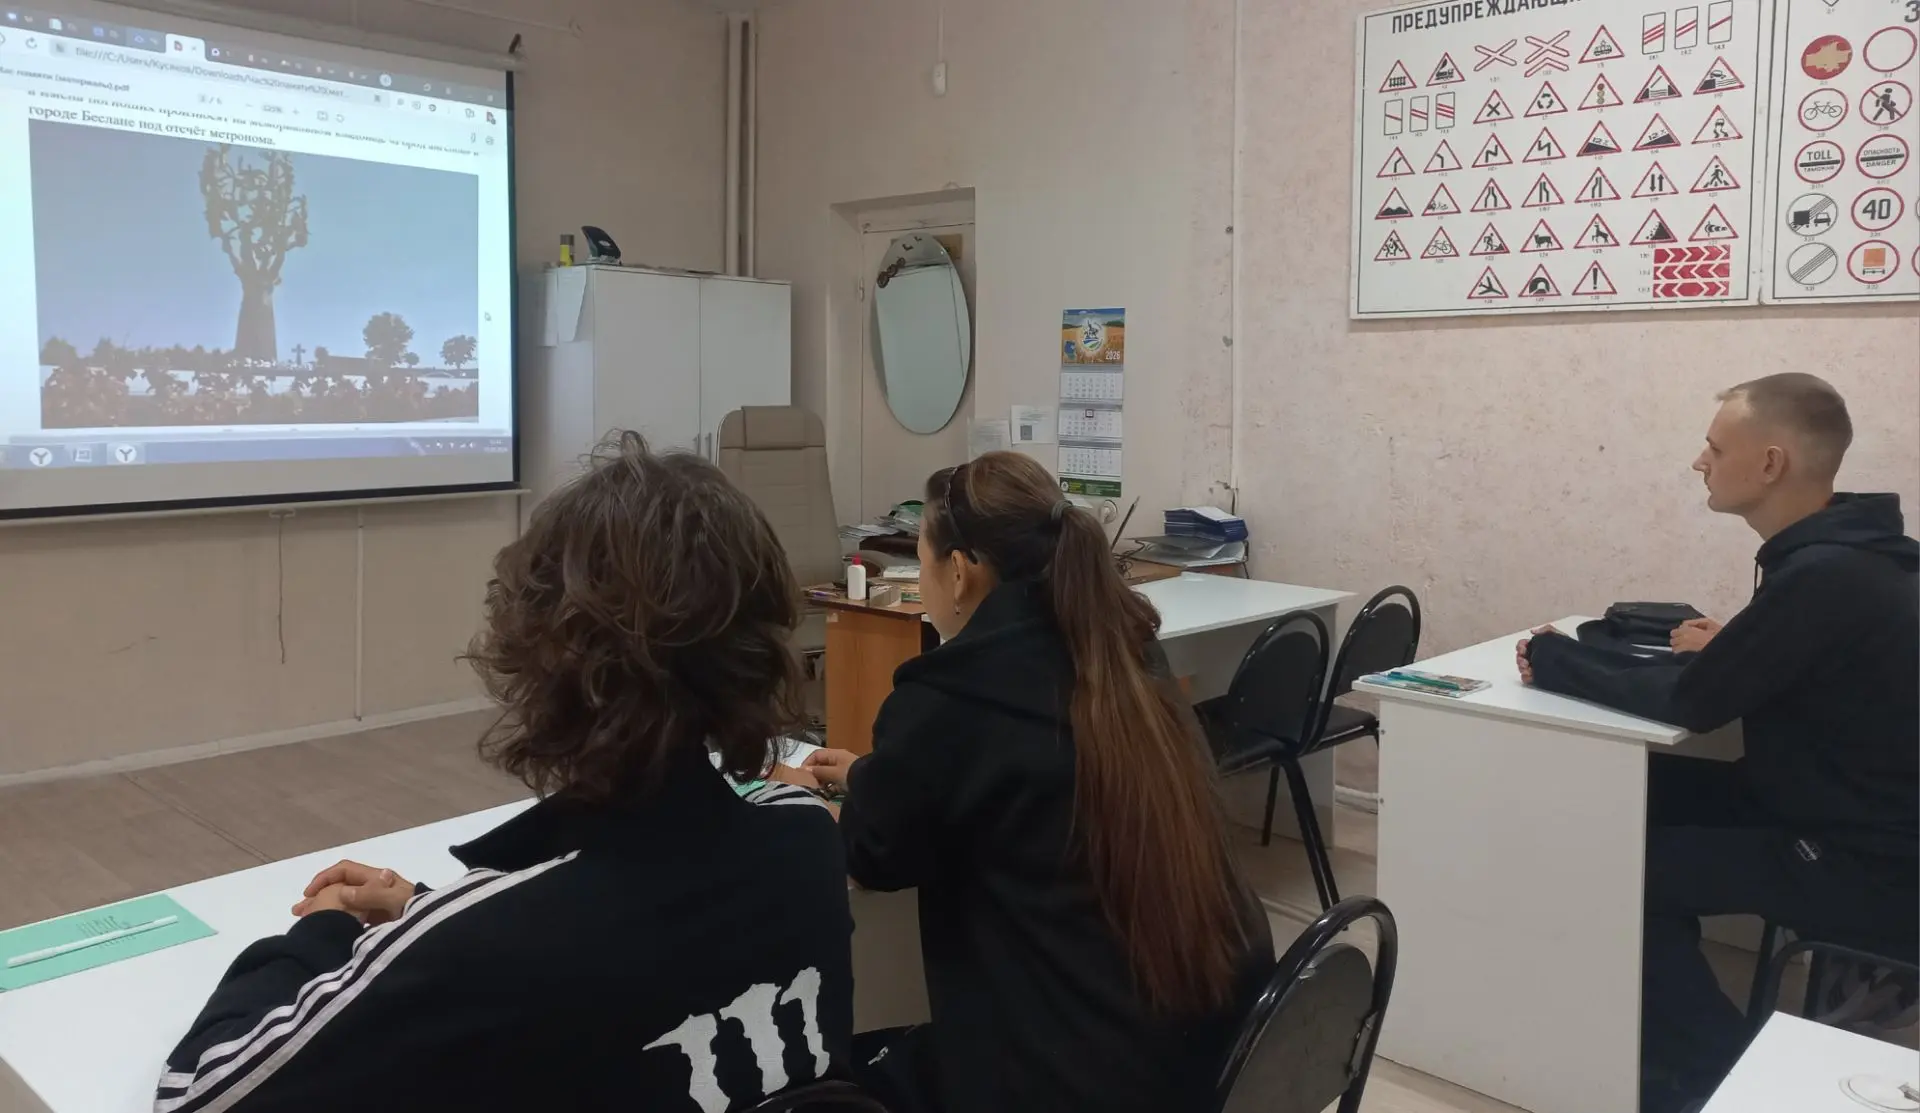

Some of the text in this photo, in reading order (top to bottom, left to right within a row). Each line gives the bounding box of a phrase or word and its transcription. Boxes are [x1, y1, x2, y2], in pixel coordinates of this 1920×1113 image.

[1392, 0, 1579, 34] ПРЕДУПРЕЖДАЮ
[28, 106, 276, 146] городе Беслане под отсчёт метронома.
[1806, 149, 1833, 161] TOLL
[1863, 147, 1901, 156] ОПАСНОСТЬ
[1866, 159, 1897, 168] DANGER
[1862, 198, 1892, 220] 40
